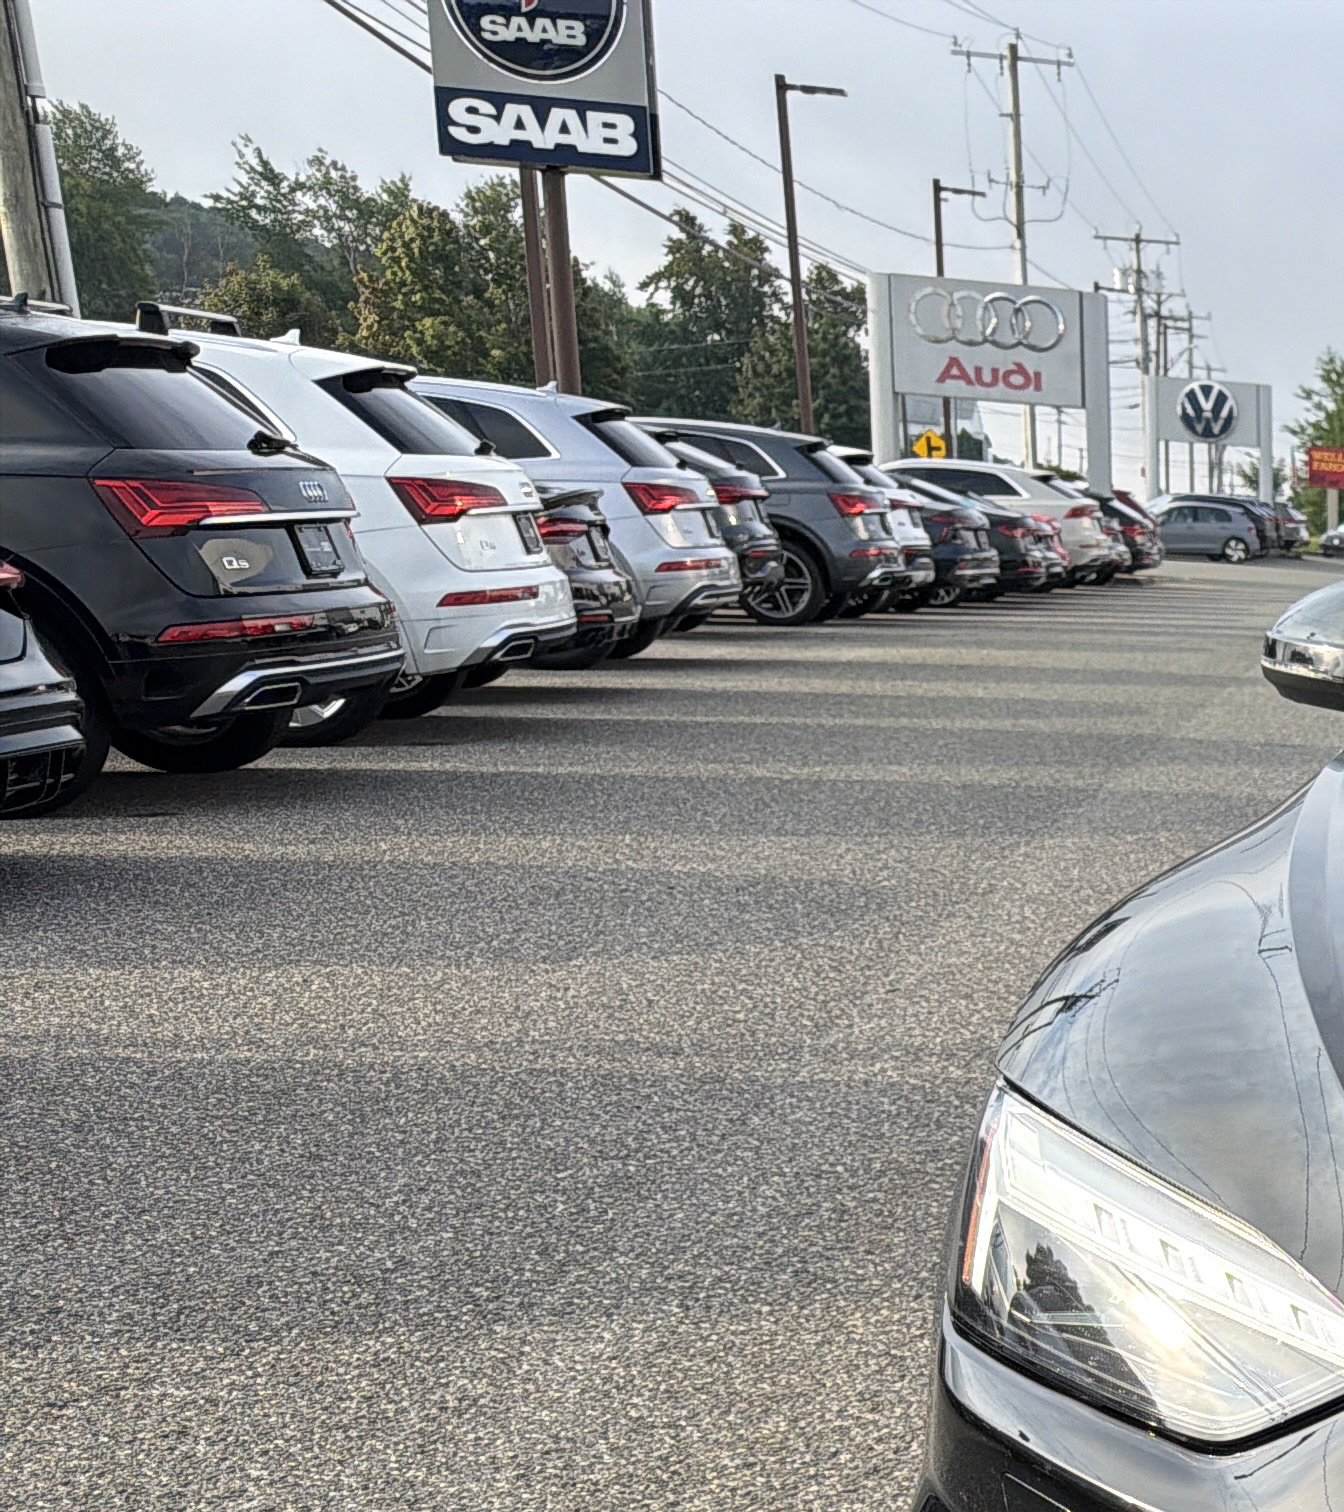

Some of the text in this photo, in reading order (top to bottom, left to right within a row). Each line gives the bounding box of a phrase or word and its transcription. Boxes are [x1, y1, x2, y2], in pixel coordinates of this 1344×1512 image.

[480, 14, 587, 47] SAAB
[447, 97, 638, 157] SAAB
[935, 356, 1043, 393] Audi
